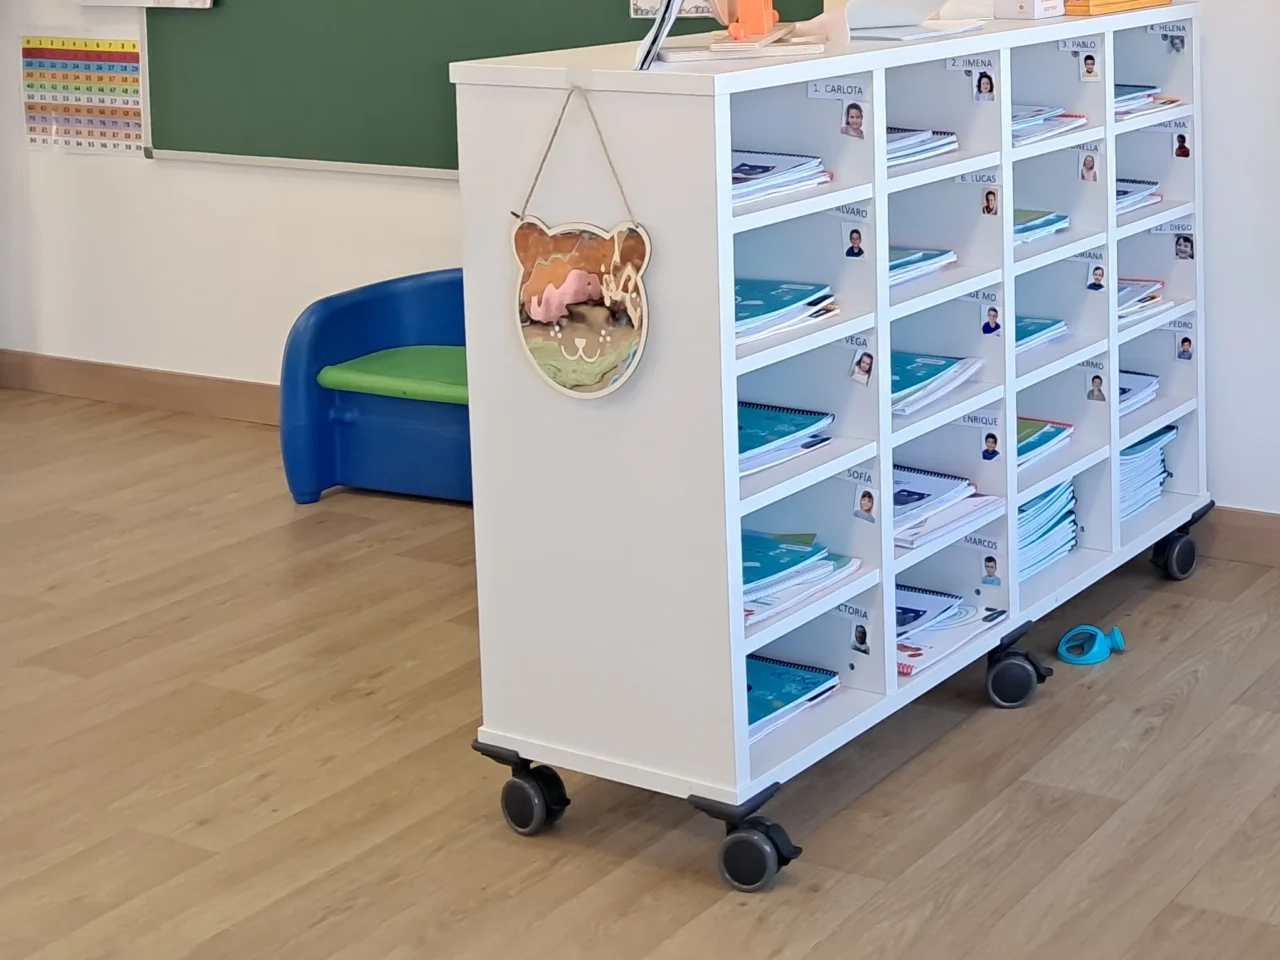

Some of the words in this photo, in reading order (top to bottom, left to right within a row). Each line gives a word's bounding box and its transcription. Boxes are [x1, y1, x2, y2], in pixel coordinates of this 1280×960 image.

[1072, 41, 1096, 49] PABLO
[952, 58, 959, 67] 2.
[961, 59, 993, 68] JIMENA
[813, 84, 821, 93] 1.
[825, 84, 863, 96] CARLOTA
[971, 174, 996, 183] LUCAS
[1170, 223, 1193, 232] DIEGO
[1168, 320, 1193, 330] PEDRO
[845, 336, 868, 348] VEGA
[963, 414, 999, 427] ENRIQUE
[847, 469, 873, 484] SOFÍA
[964, 536, 998, 550] MARCOS
